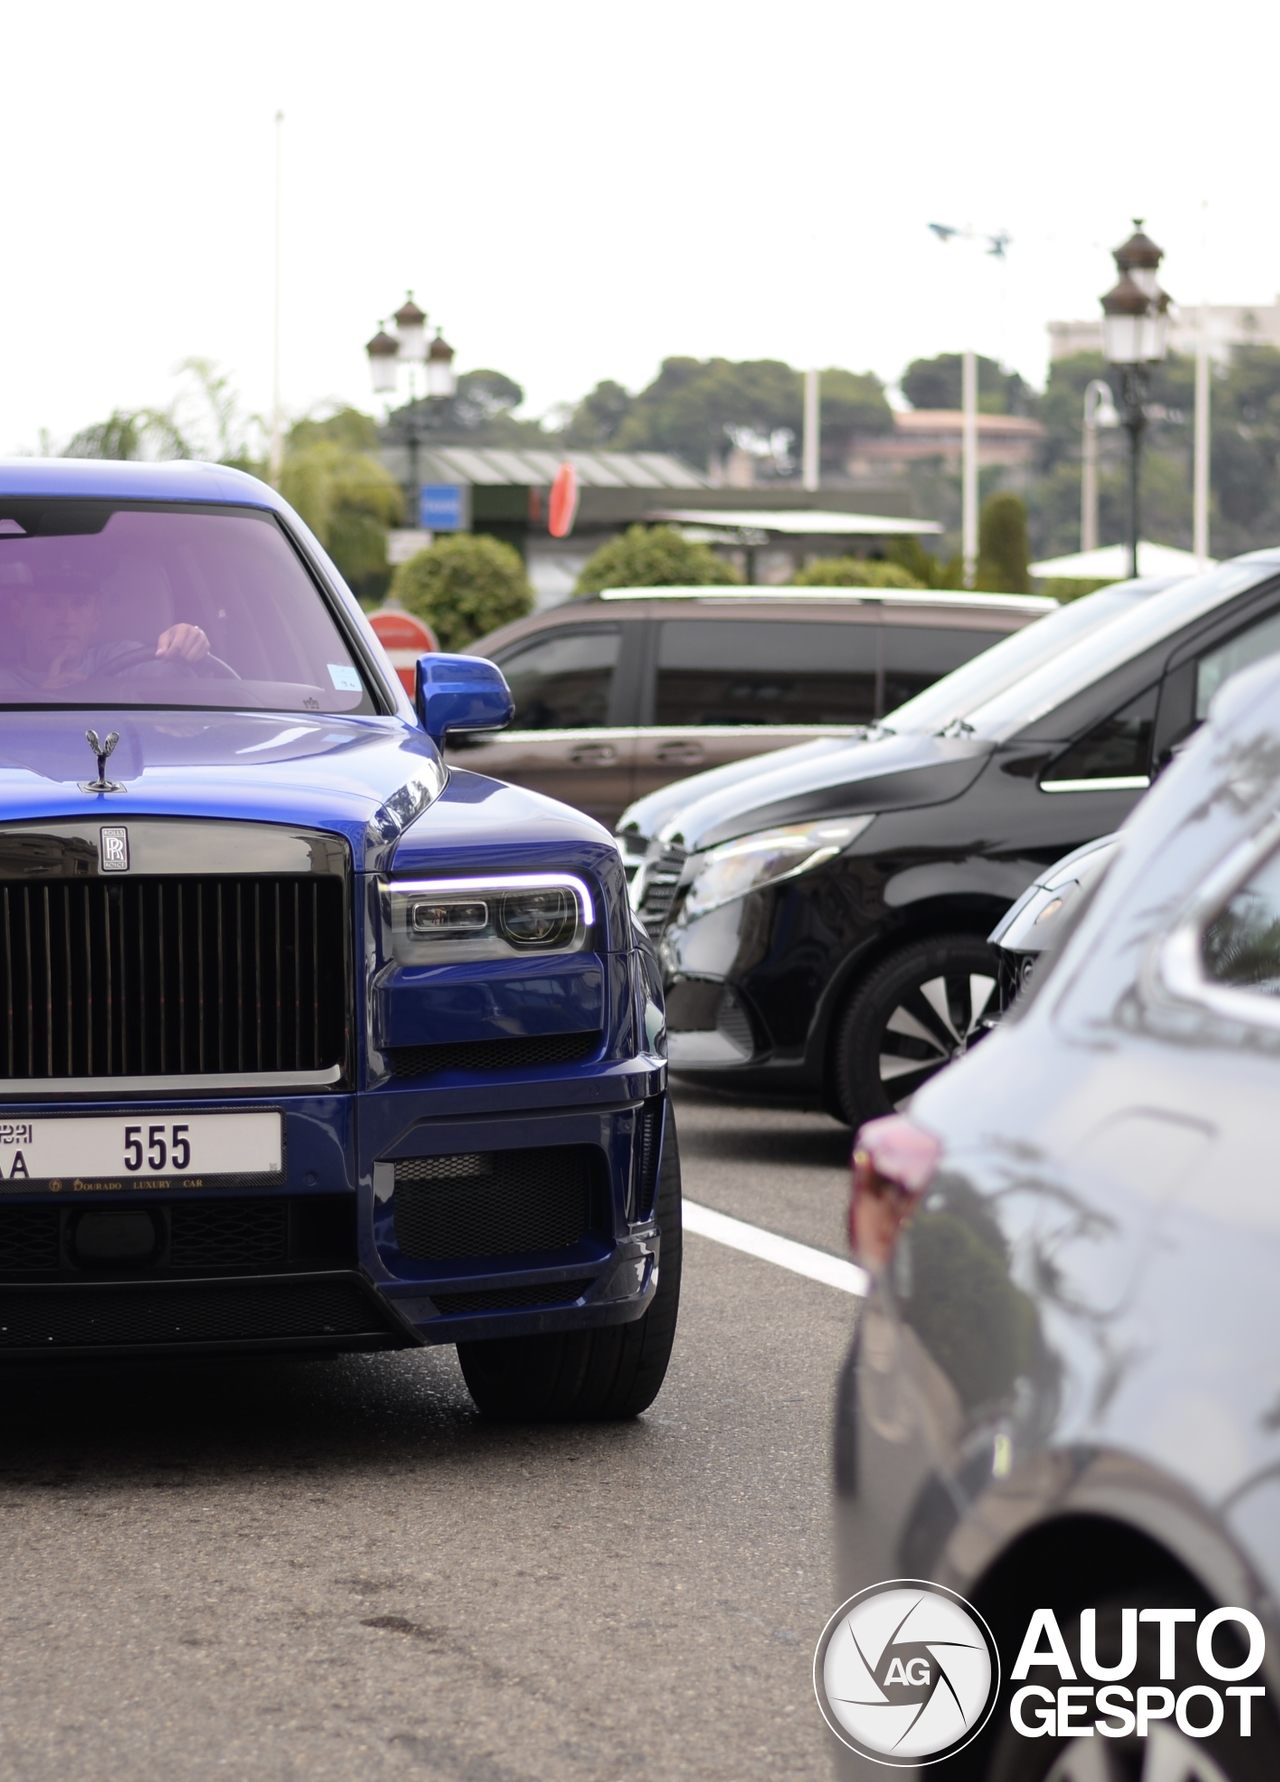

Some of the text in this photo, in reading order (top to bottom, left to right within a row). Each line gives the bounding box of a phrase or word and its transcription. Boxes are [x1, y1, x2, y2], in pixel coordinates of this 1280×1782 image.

[124, 1124, 191, 1171] 555
[133, 1179, 171, 1189] LUXURY
[183, 1179, 204, 1188] CAR
